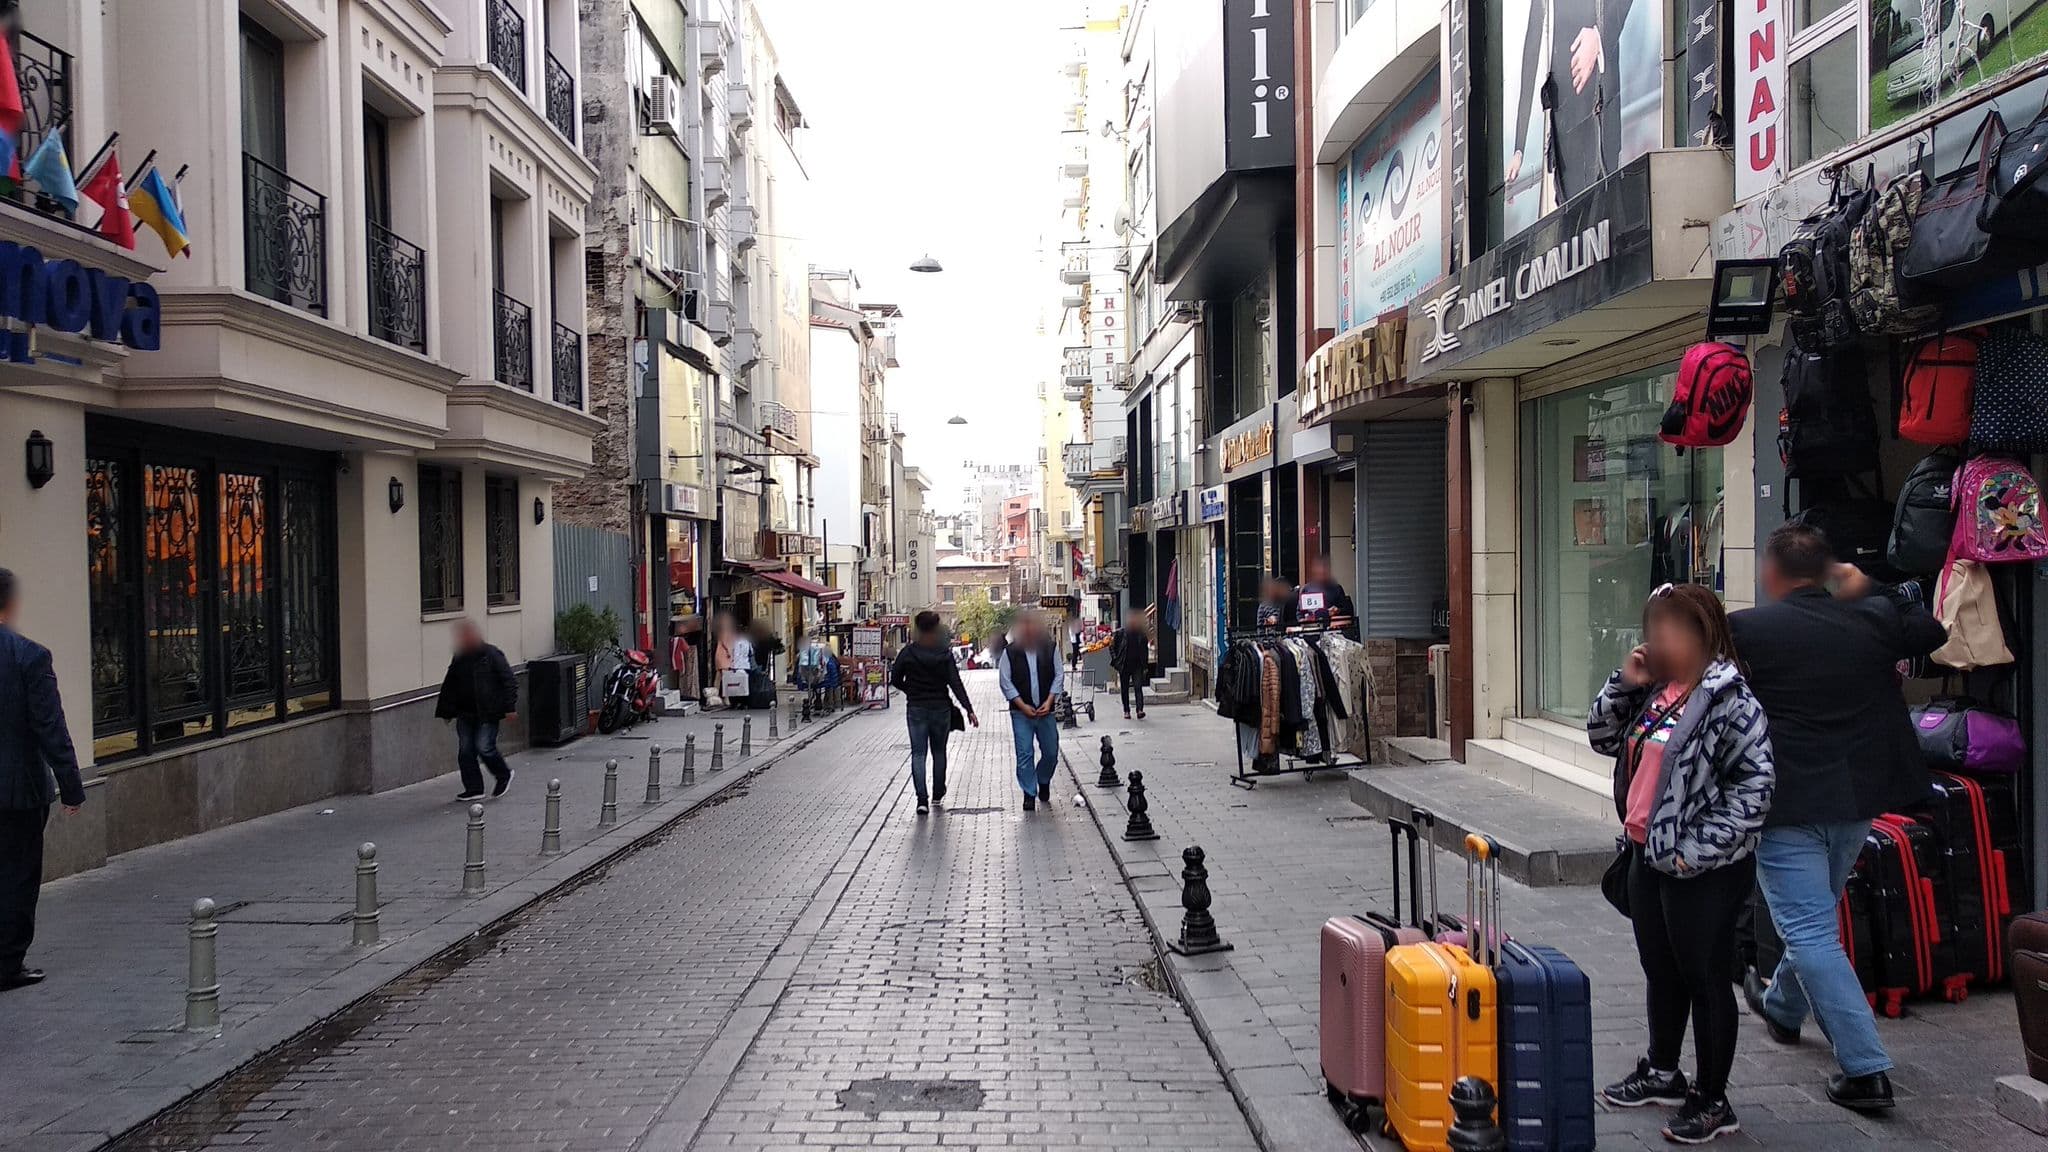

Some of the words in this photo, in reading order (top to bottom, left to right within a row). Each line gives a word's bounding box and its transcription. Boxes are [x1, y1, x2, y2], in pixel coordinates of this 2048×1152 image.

[1748, 0, 1776, 171] NAU
[1373, 240, 1387, 271] AL
[1388, 213, 1421, 260] NOUR
[1458, 277, 1511, 330] DANIEL
[1515, 219, 1610, 300] CAVALLINI
[1104, 297, 1115, 382] HOTEL
[1708, 369, 1747, 420] NIKE
[881, 616, 906, 624] HOTEL
[1042, 597, 1069, 606] HOTEL
